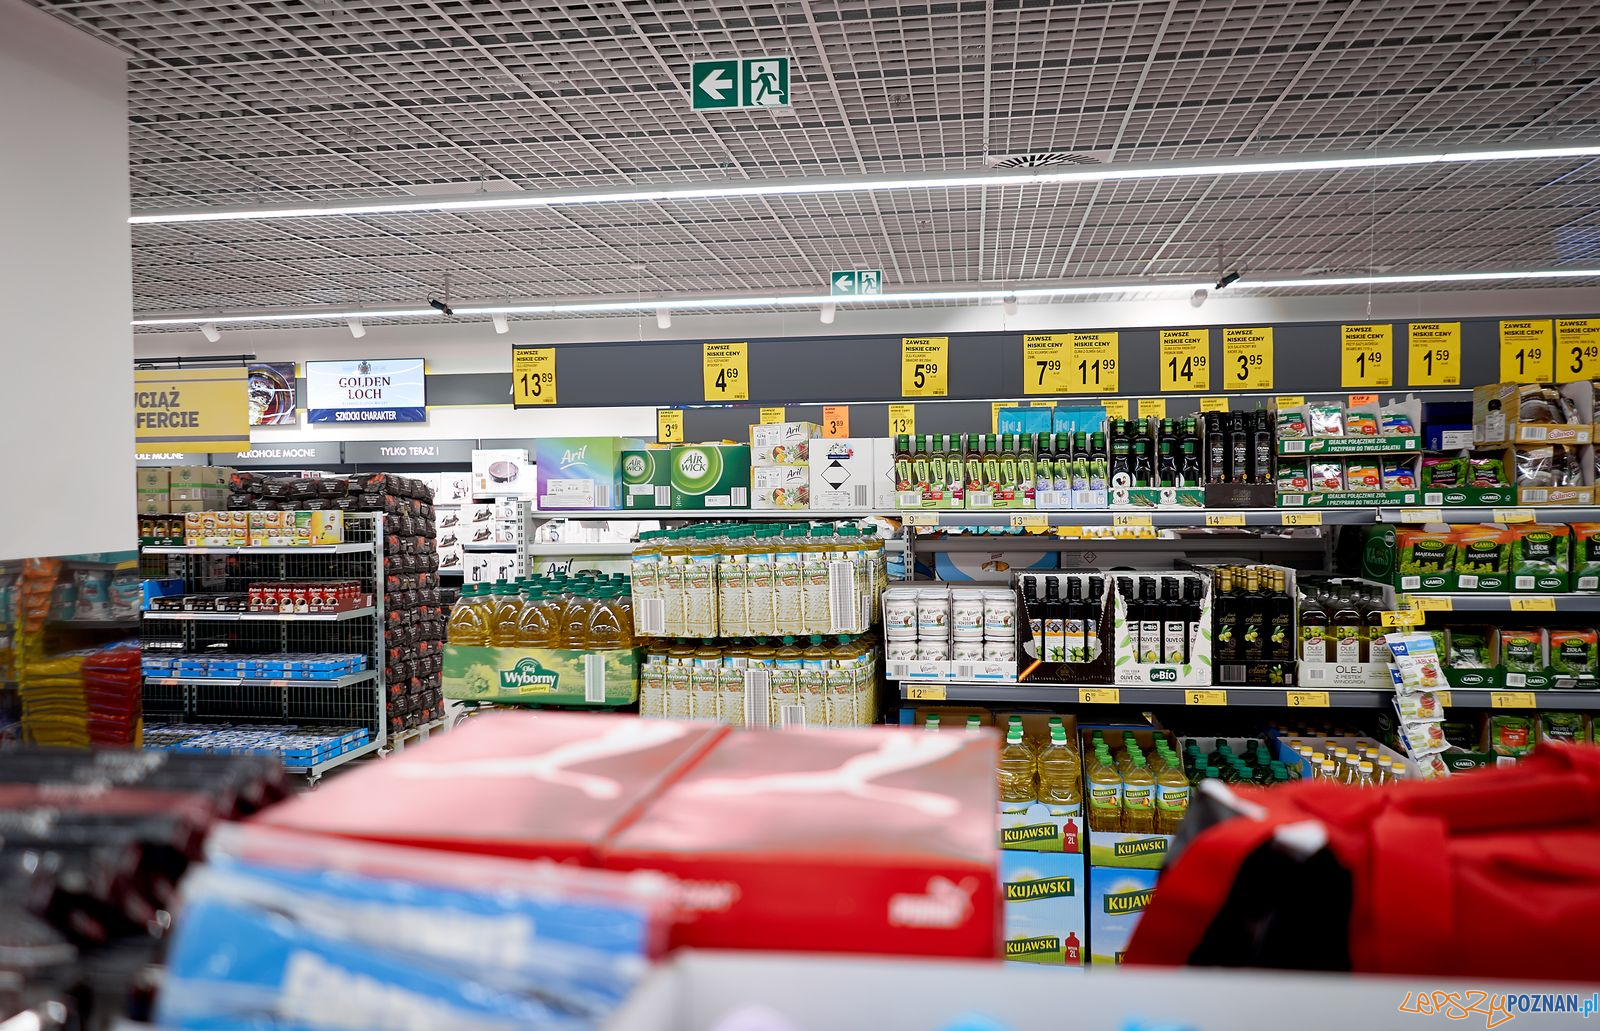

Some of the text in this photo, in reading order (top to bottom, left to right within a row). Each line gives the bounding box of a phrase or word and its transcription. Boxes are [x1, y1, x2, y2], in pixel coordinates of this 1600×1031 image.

[339, 376, 391, 388] GOLDEN
[135, 386, 180, 412] CIĄŻ
[348, 388, 382, 400] LOCH
[136, 411, 199, 428] FERCIE
[335, 411, 397, 421] SZKOCKI CHARAKTER
[786, 425, 801, 435] Aril
[237, 449, 315, 459] ALKOHOLE MOCNE
[381, 447, 434, 456] TYLKO TERAZ
[560, 444, 587, 464] Aril
[626, 464, 643, 472] WICK
[681, 464, 706, 472] WICK
[787, 467, 802, 478] Aril
[546, 558, 573, 577] Aril
[504, 671, 556, 686] Wyborny
[1004, 827, 1055, 840] KUJAWSKI
[1118, 841, 1164, 854] KUJAWSKI
[1007, 881, 1071, 898] KUJAWSKI
[1007, 939, 1056, 953] KUJAWSKI
[1069, 950, 1076, 958] 2L
